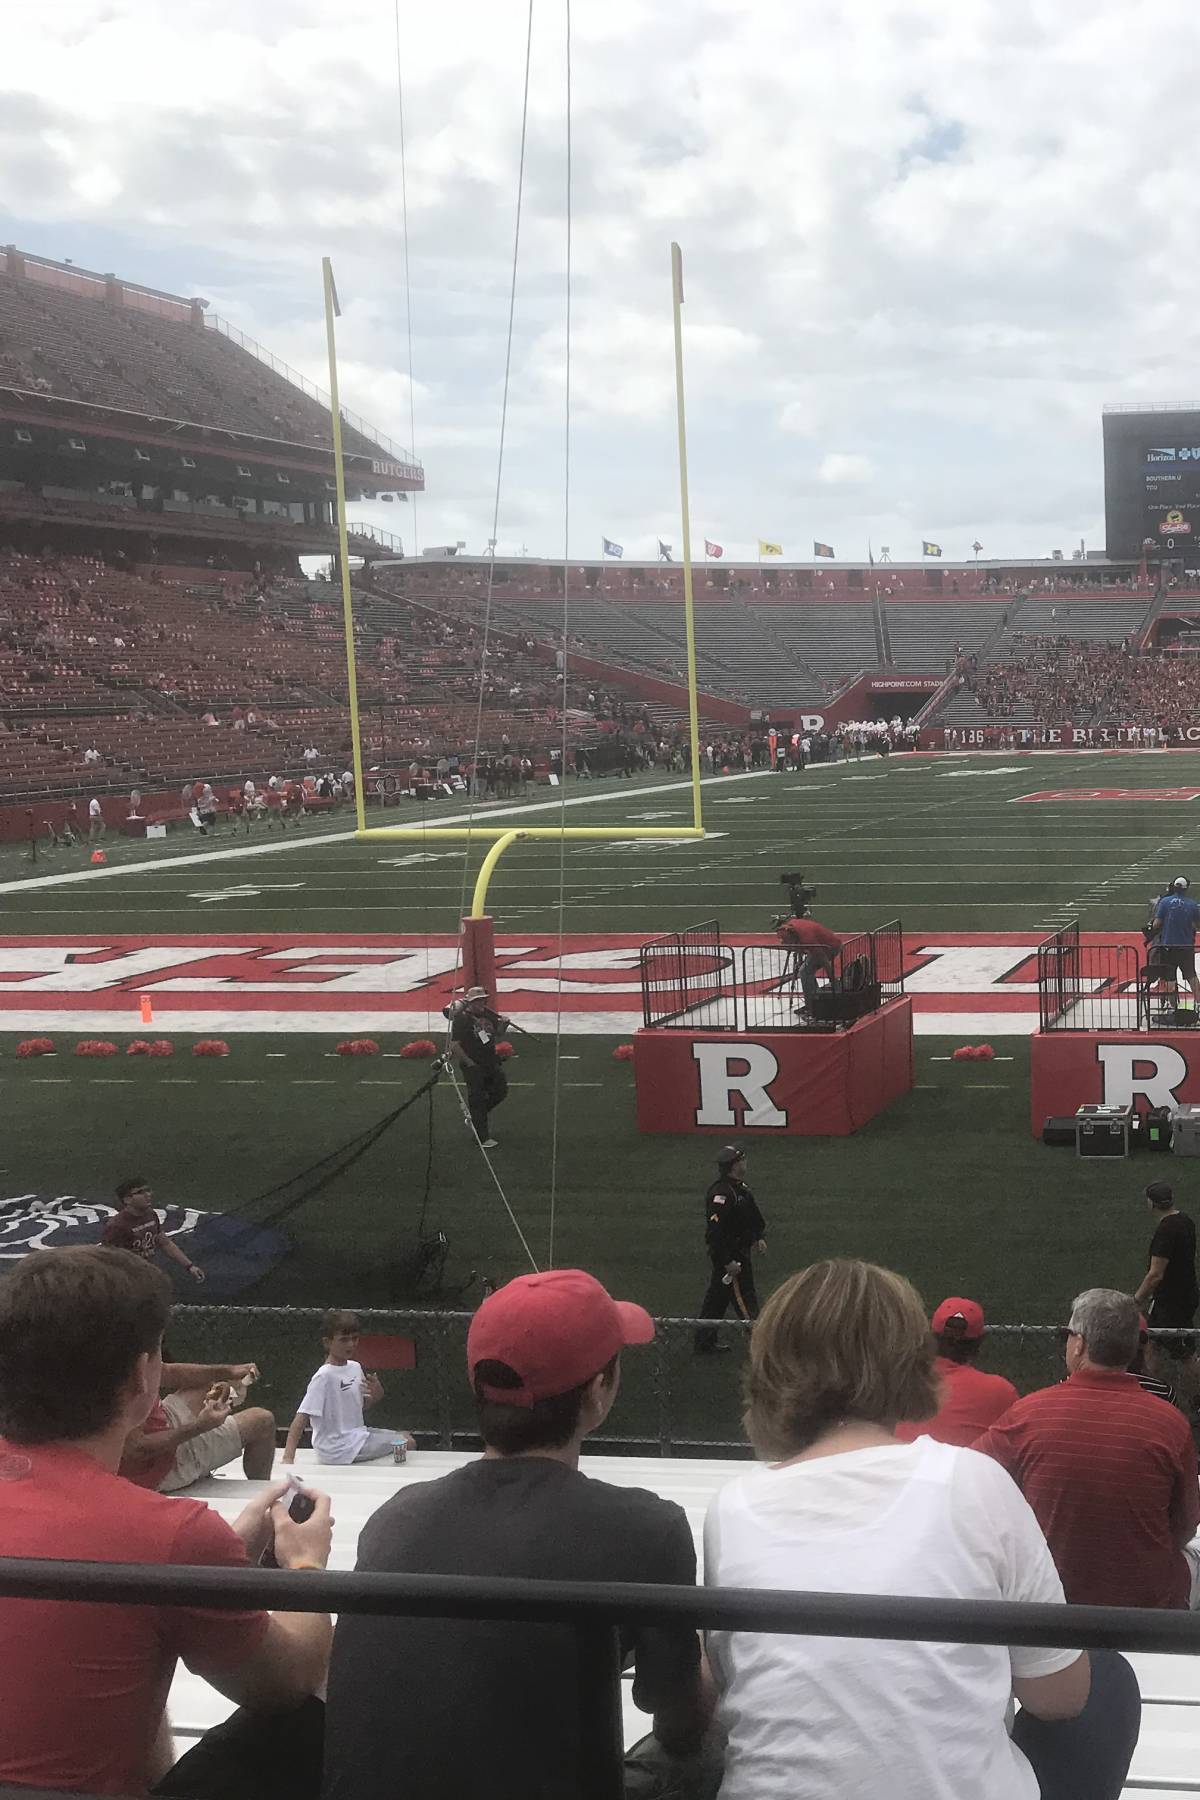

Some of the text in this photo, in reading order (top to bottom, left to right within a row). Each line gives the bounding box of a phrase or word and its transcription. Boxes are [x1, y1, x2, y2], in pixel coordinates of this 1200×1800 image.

[372, 461, 423, 480] RUTGERS
[1167, 538, 1175, 549] 0
[692, 1041, 788, 1128] R
[1097, 1044, 1187, 1115] R
